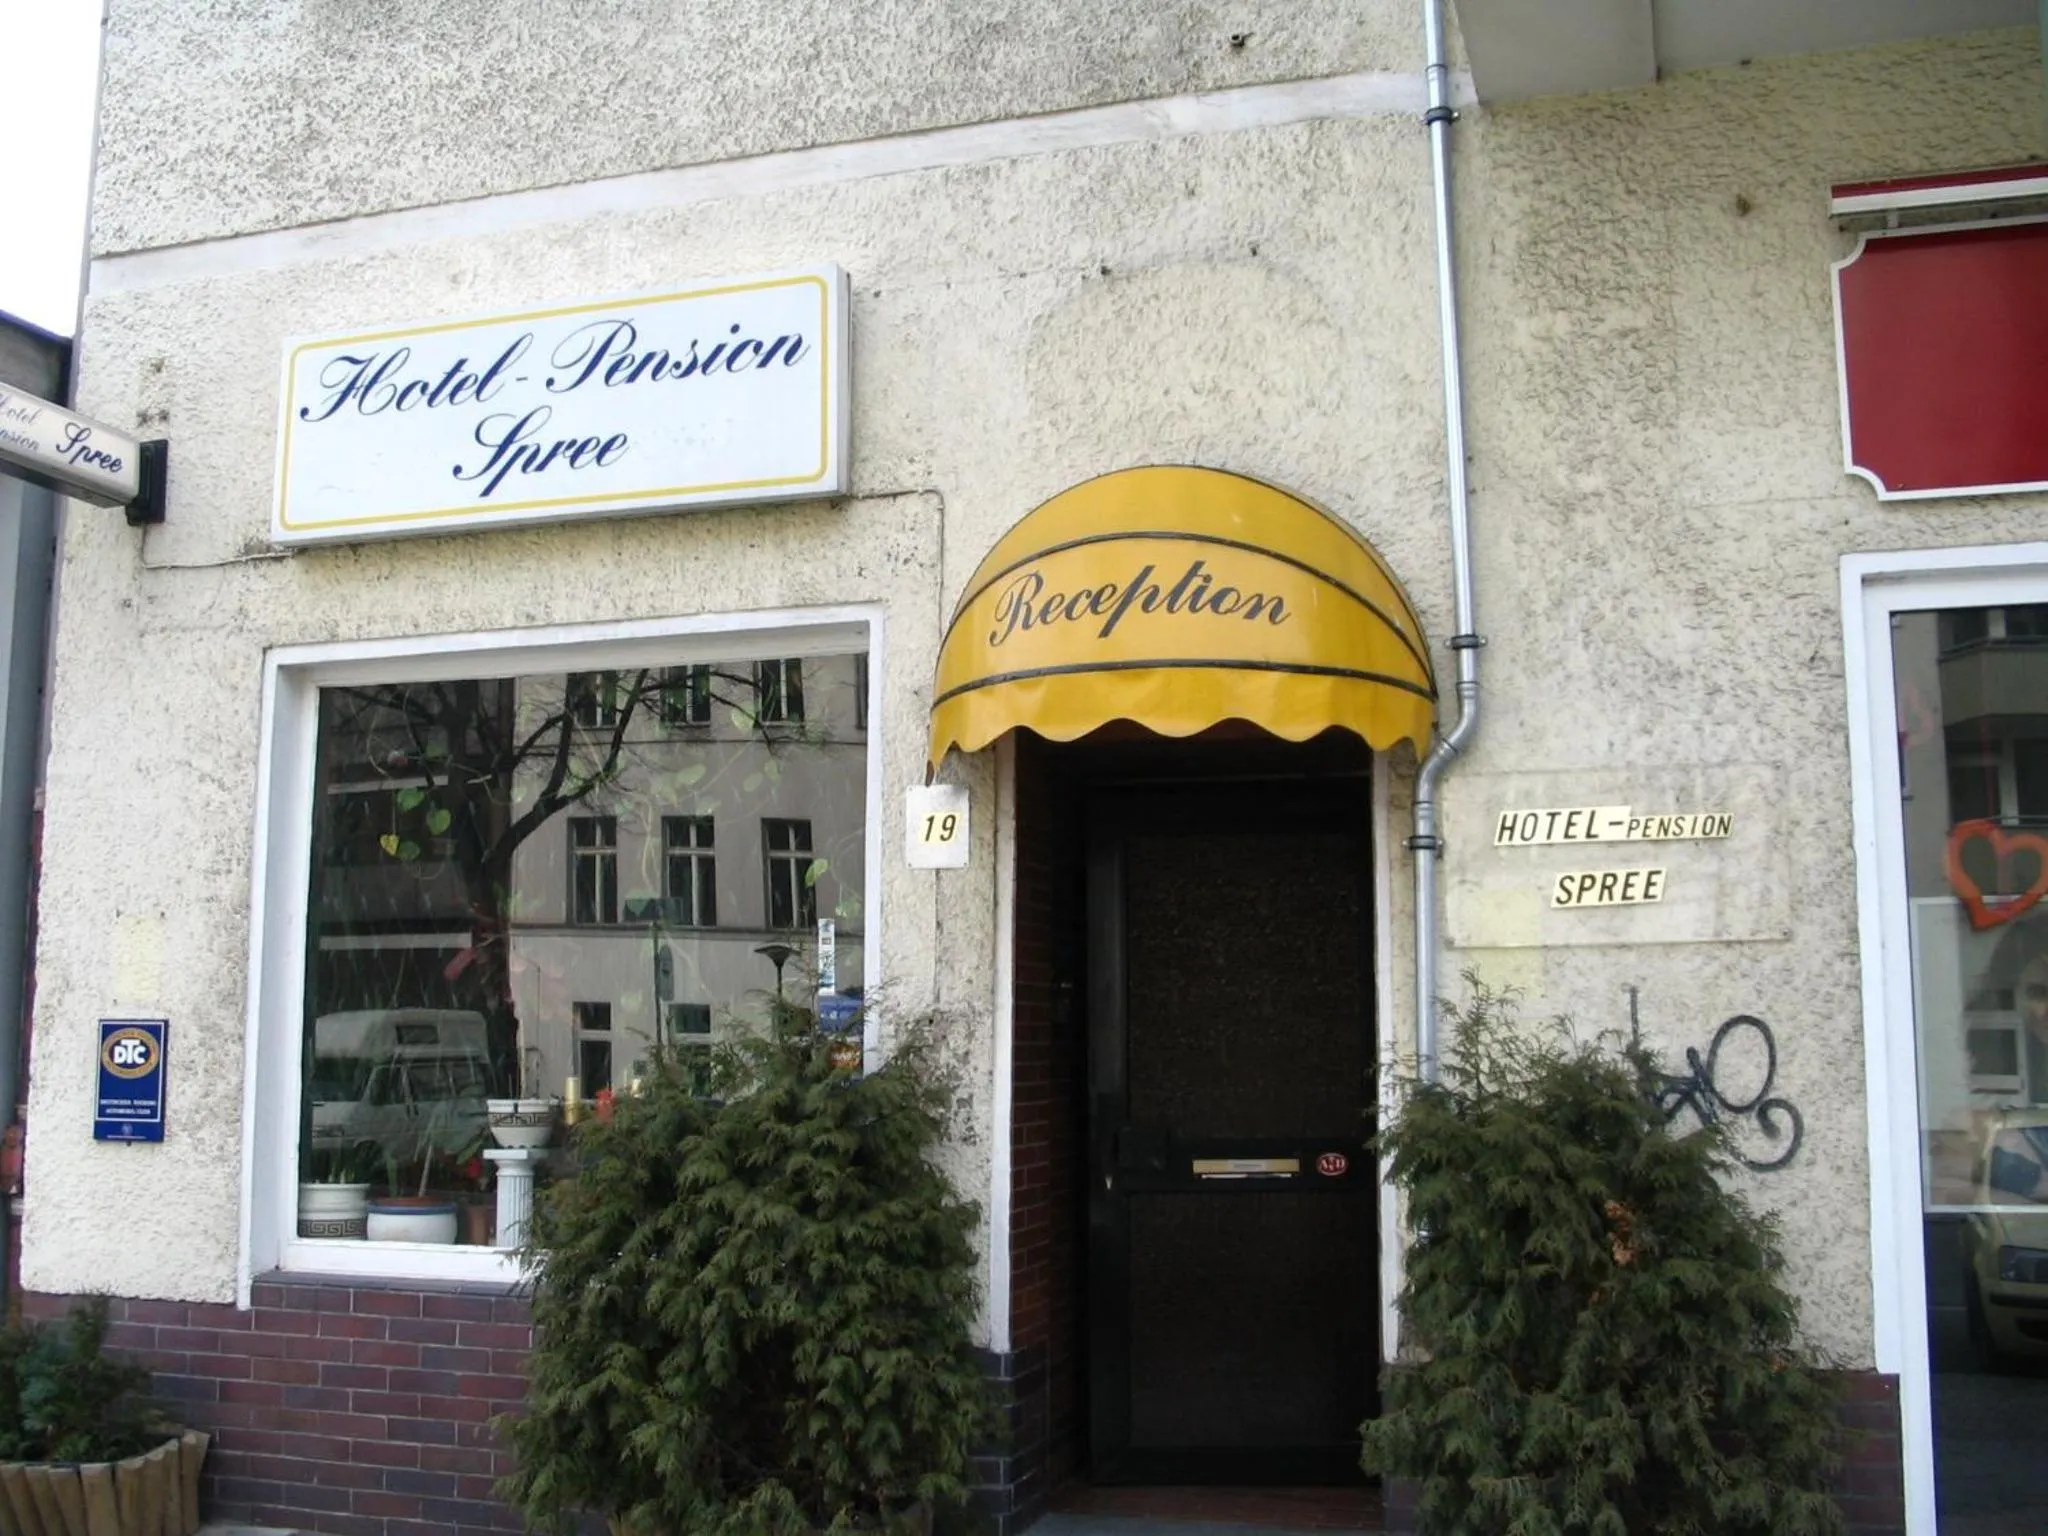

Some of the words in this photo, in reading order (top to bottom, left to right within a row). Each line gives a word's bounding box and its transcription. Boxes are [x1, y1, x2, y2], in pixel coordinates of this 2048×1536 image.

[55, 421, 124, 474] Spree
[450, 403, 629, 498] Spree
[988, 559, 1293, 648] Reception
[922, 813, 958, 842] 19
[1555, 869, 1664, 906] SPREE
